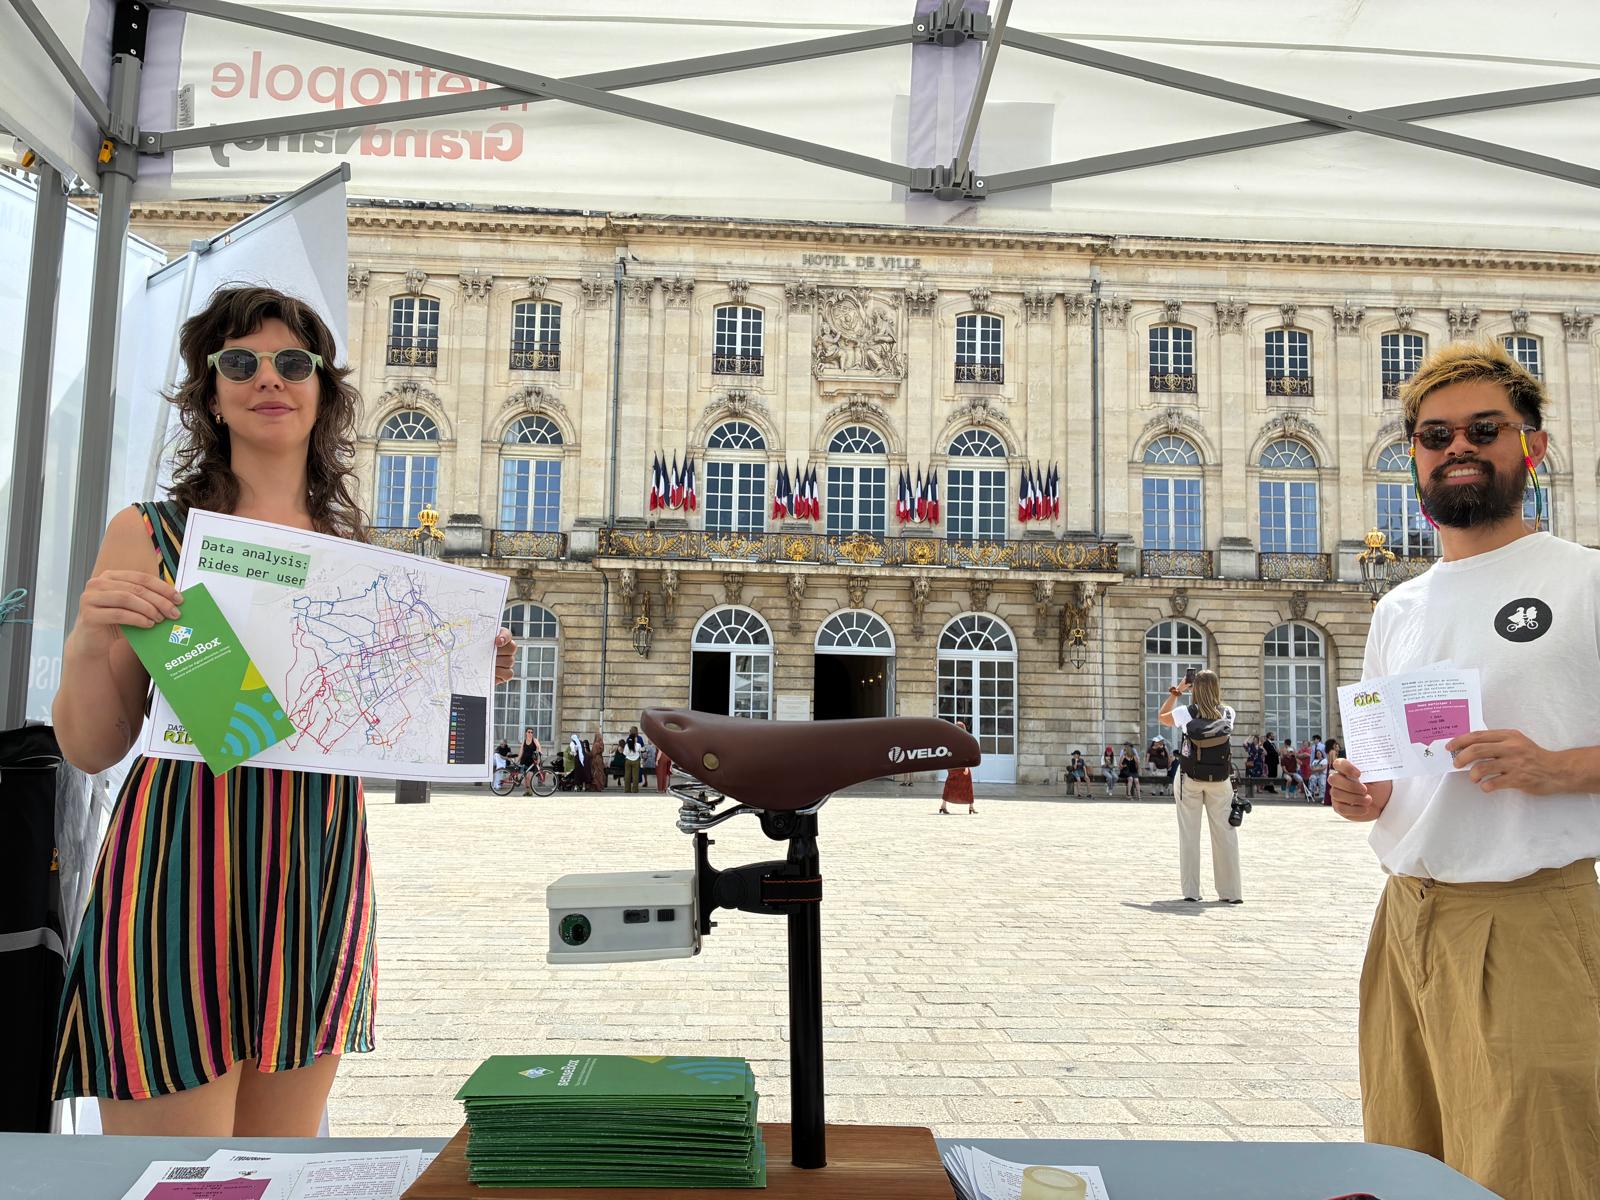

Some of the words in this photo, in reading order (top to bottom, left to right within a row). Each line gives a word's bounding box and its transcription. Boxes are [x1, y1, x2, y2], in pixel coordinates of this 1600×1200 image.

[855, 256, 875, 268] DE
[881, 256, 921, 269] VILLE
[201, 539, 234, 554] Data
[242, 548, 307, 569] analysis:
[198, 556, 239, 573] Rides
[246, 567, 269, 578] per
[277, 573, 306, 586] user
[164, 637, 222, 671] senseBox
[557, 1059, 580, 1087] senseBox
